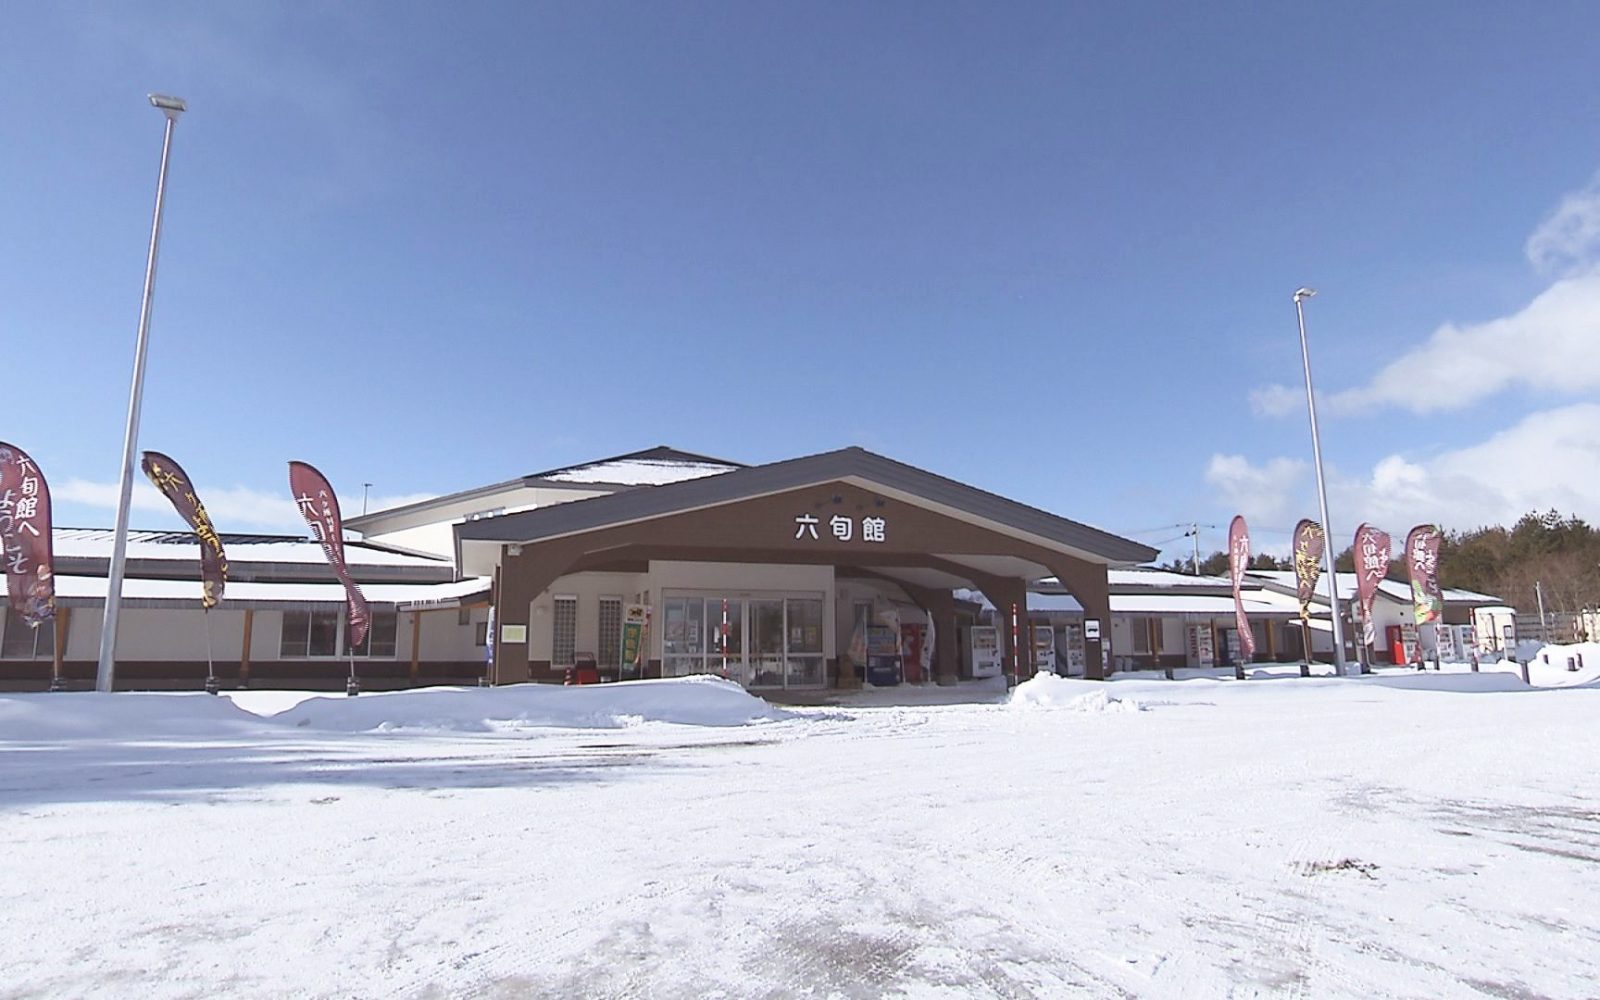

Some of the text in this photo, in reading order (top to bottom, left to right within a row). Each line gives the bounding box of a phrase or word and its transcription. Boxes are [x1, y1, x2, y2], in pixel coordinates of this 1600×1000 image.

[15, 455, 40, 536] 六旬館へ
[795, 514, 885, 541] 六旬館
